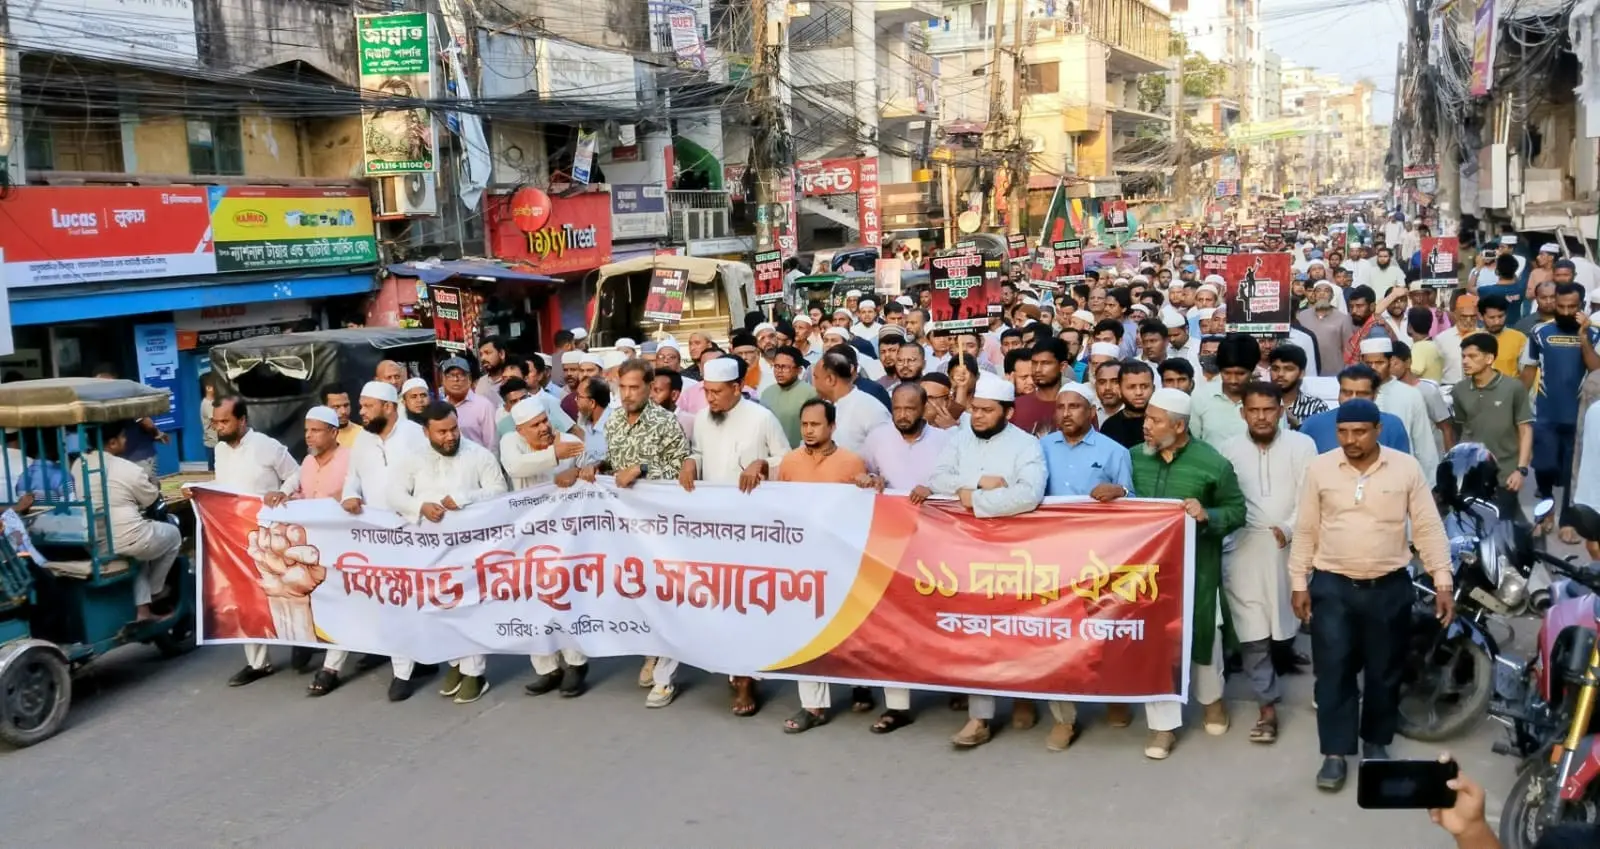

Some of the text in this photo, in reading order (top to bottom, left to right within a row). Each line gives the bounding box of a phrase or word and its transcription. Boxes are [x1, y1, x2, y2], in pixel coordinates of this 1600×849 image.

[51, 208, 97, 228] Lucas
[351, 527, 413, 546] গণভোটের
[417, 532, 439, 549] রায়
[443, 523, 516, 547] বাস্তবায়ন
[521, 519, 558, 537] এবং
[618, 514, 669, 535] সংকট
[673, 515, 746, 542] নিরসনের
[749, 519, 804, 545] দাবীতে
[333, 544, 828, 620] বিক্ষোভ মিছিল ও সমাবেশ
[914, 549, 1159, 605] ১১ দলীয় ঐক্য
[544, 622, 566, 635] ১২
[567, 614, 605, 636] এপ্রিল
[608, 619, 652, 634] ২০২৬
[936, 612, 1145, 641] কক্সবাজার জেলা
